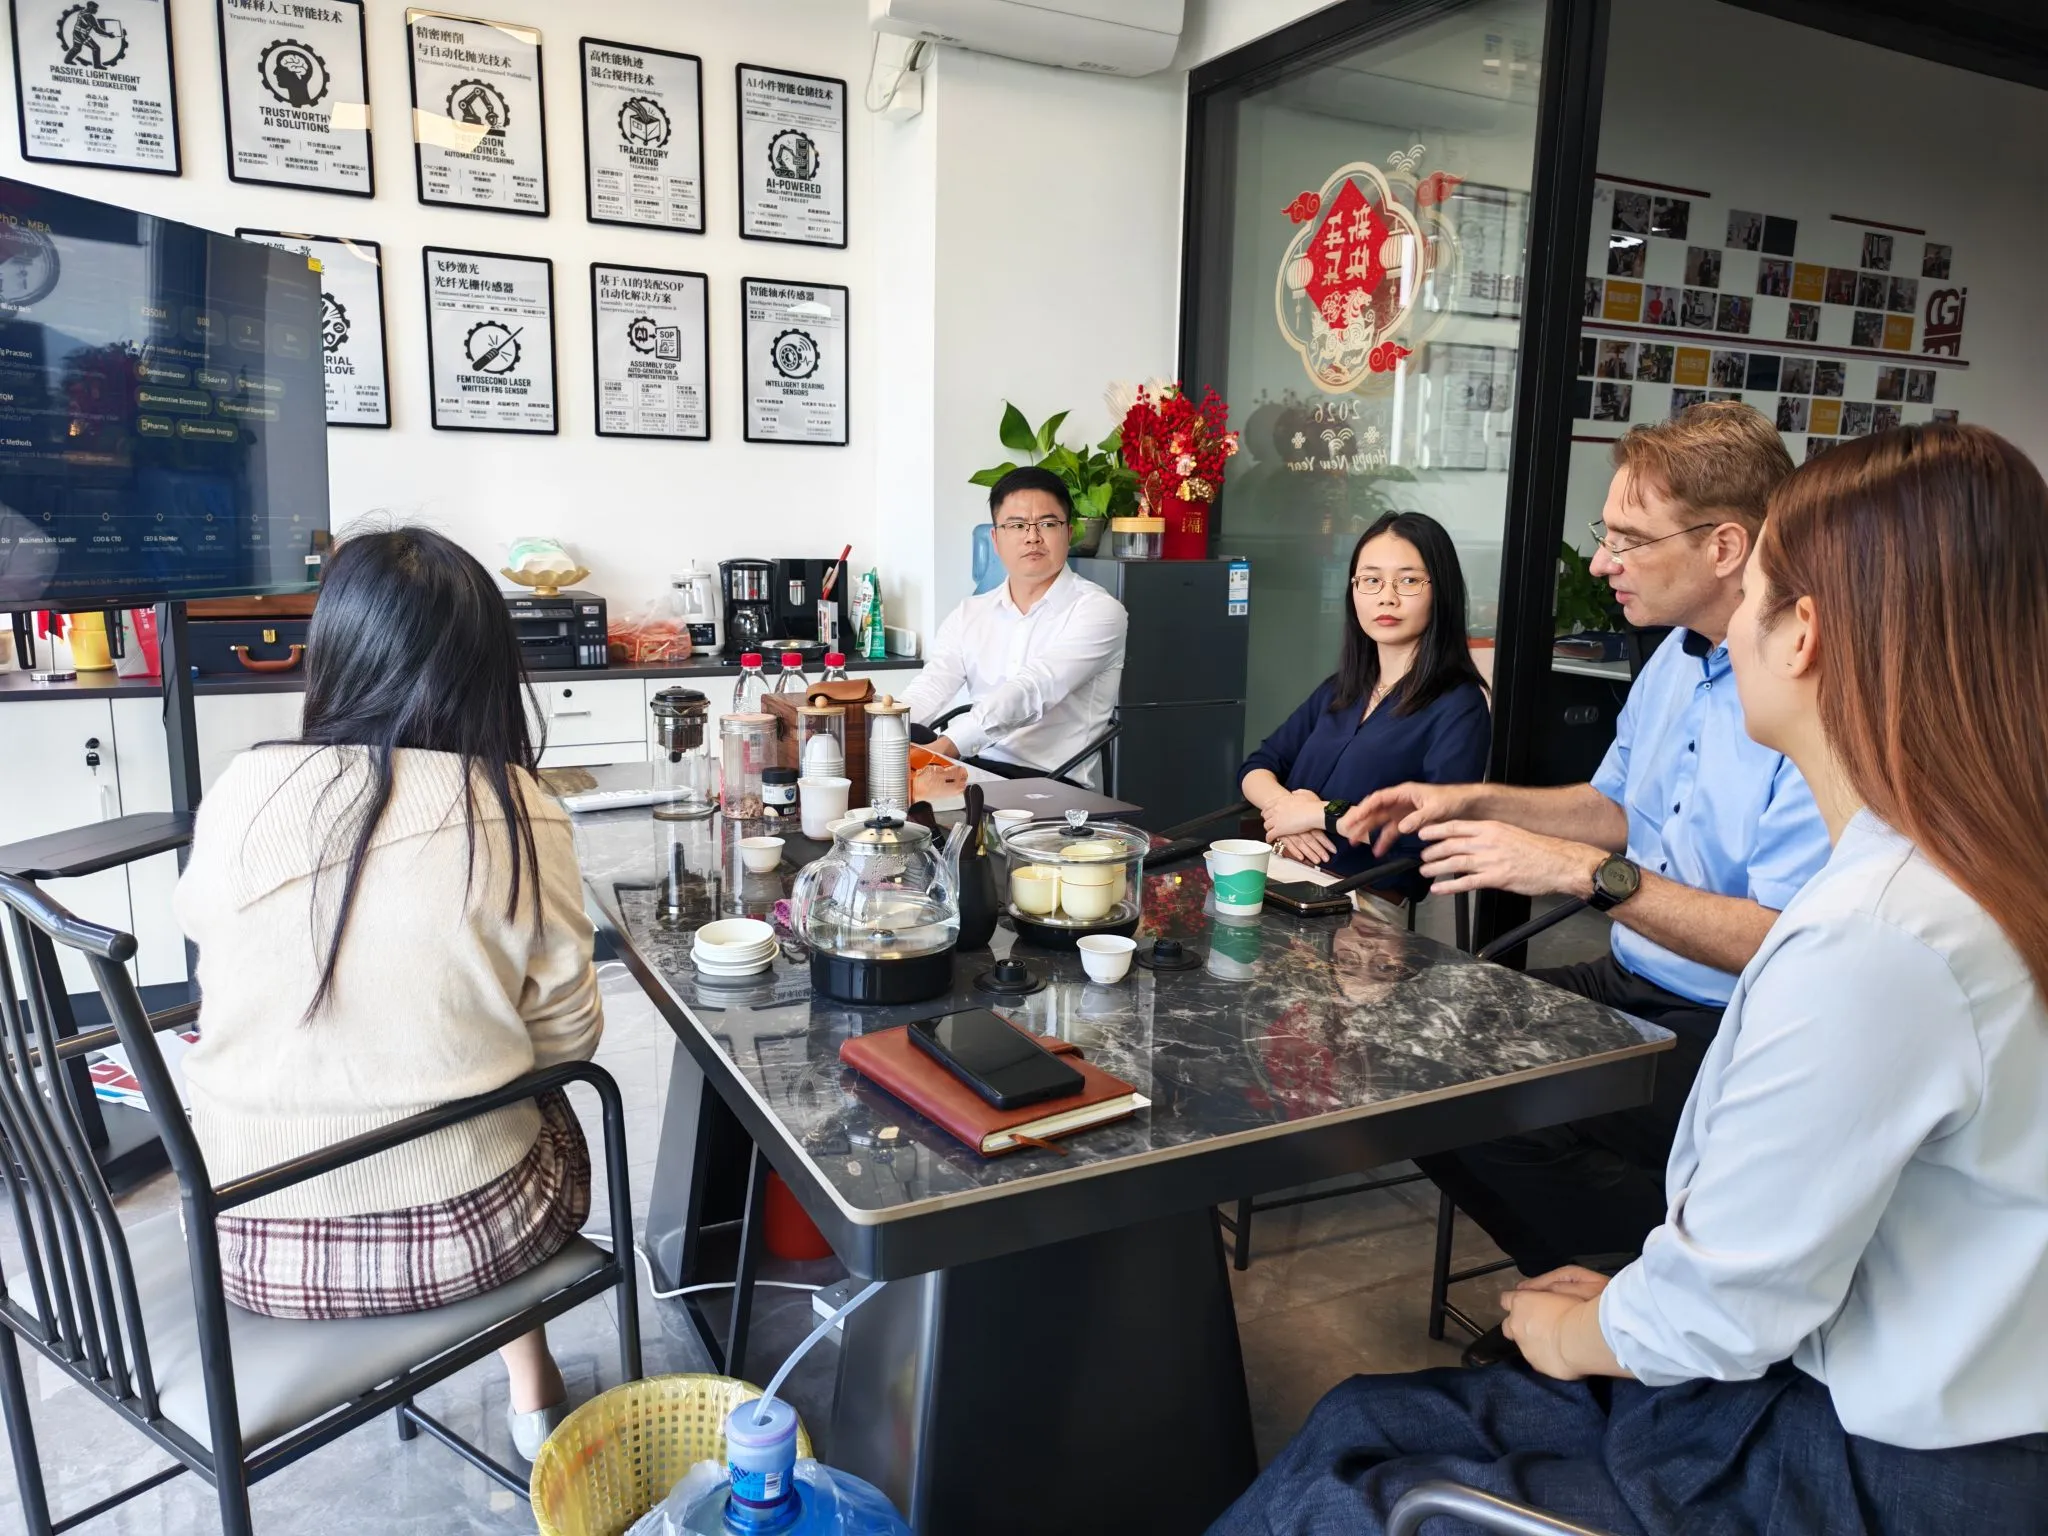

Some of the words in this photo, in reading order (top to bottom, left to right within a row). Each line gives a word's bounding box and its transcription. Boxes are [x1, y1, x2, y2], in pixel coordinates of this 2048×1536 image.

[228, 0, 343, 24] 可解释人工智能技术
[416, 26, 464, 45] 精密磨削
[418, 43, 512, 68] 与自动化抛光技术
[590, 50, 644, 69] 高性能轨迹
[50, 65, 84, 77] PASSIVE
[86, 70, 140, 84] LIGHTWEIGHT
[591, 66, 655, 86] 混合搅拌技术
[52, 75, 90, 86] INDUSTRIAL
[92, 80, 137, 92] EXOSKELETON
[746, 78, 833, 100] AI小件智能仓储技术
[259, 106, 332, 123] TRUSTWORTHY
[264, 117, 274, 127] AI
[276, 119, 330, 134] SOLUTIONS
[444, 150, 480, 160] AUTOMATED
[482, 155, 514, 166] POLISHING
[619, 144, 668, 159] TRAJECTORY
[629, 155, 659, 167] MIXING
[766, 178, 822, 194] AI-POWERED
[28, 220, 51, 232] MBA
[434, 260, 480, 275] 飞秒激光
[435, 276, 514, 294] 光纤光栅传感器
[600, 274, 684, 292] 基于AI的装配SOP
[600, 288, 672, 304] 自动化解决方案
[750, 286, 814, 302] 智能轴承传感器
[636, 328, 648, 341] AI
[660, 331, 674, 340] SOP
[628, 367, 673, 376] AUTO-GENERATION
[630, 360, 663, 369] ASSEMBLY
[456, 374, 508, 386] FEMTOSECOND
[510, 378, 532, 387] LASER
[766, 380, 800, 389] INTELLIGENT
[801, 382, 824, 390] BEARING
[462, 384, 490, 393] WRITTEN
[504, 387, 528, 395] SENSOR
[782, 388, 808, 397] SENSORS
[148, 422, 168, 430] Pharma
